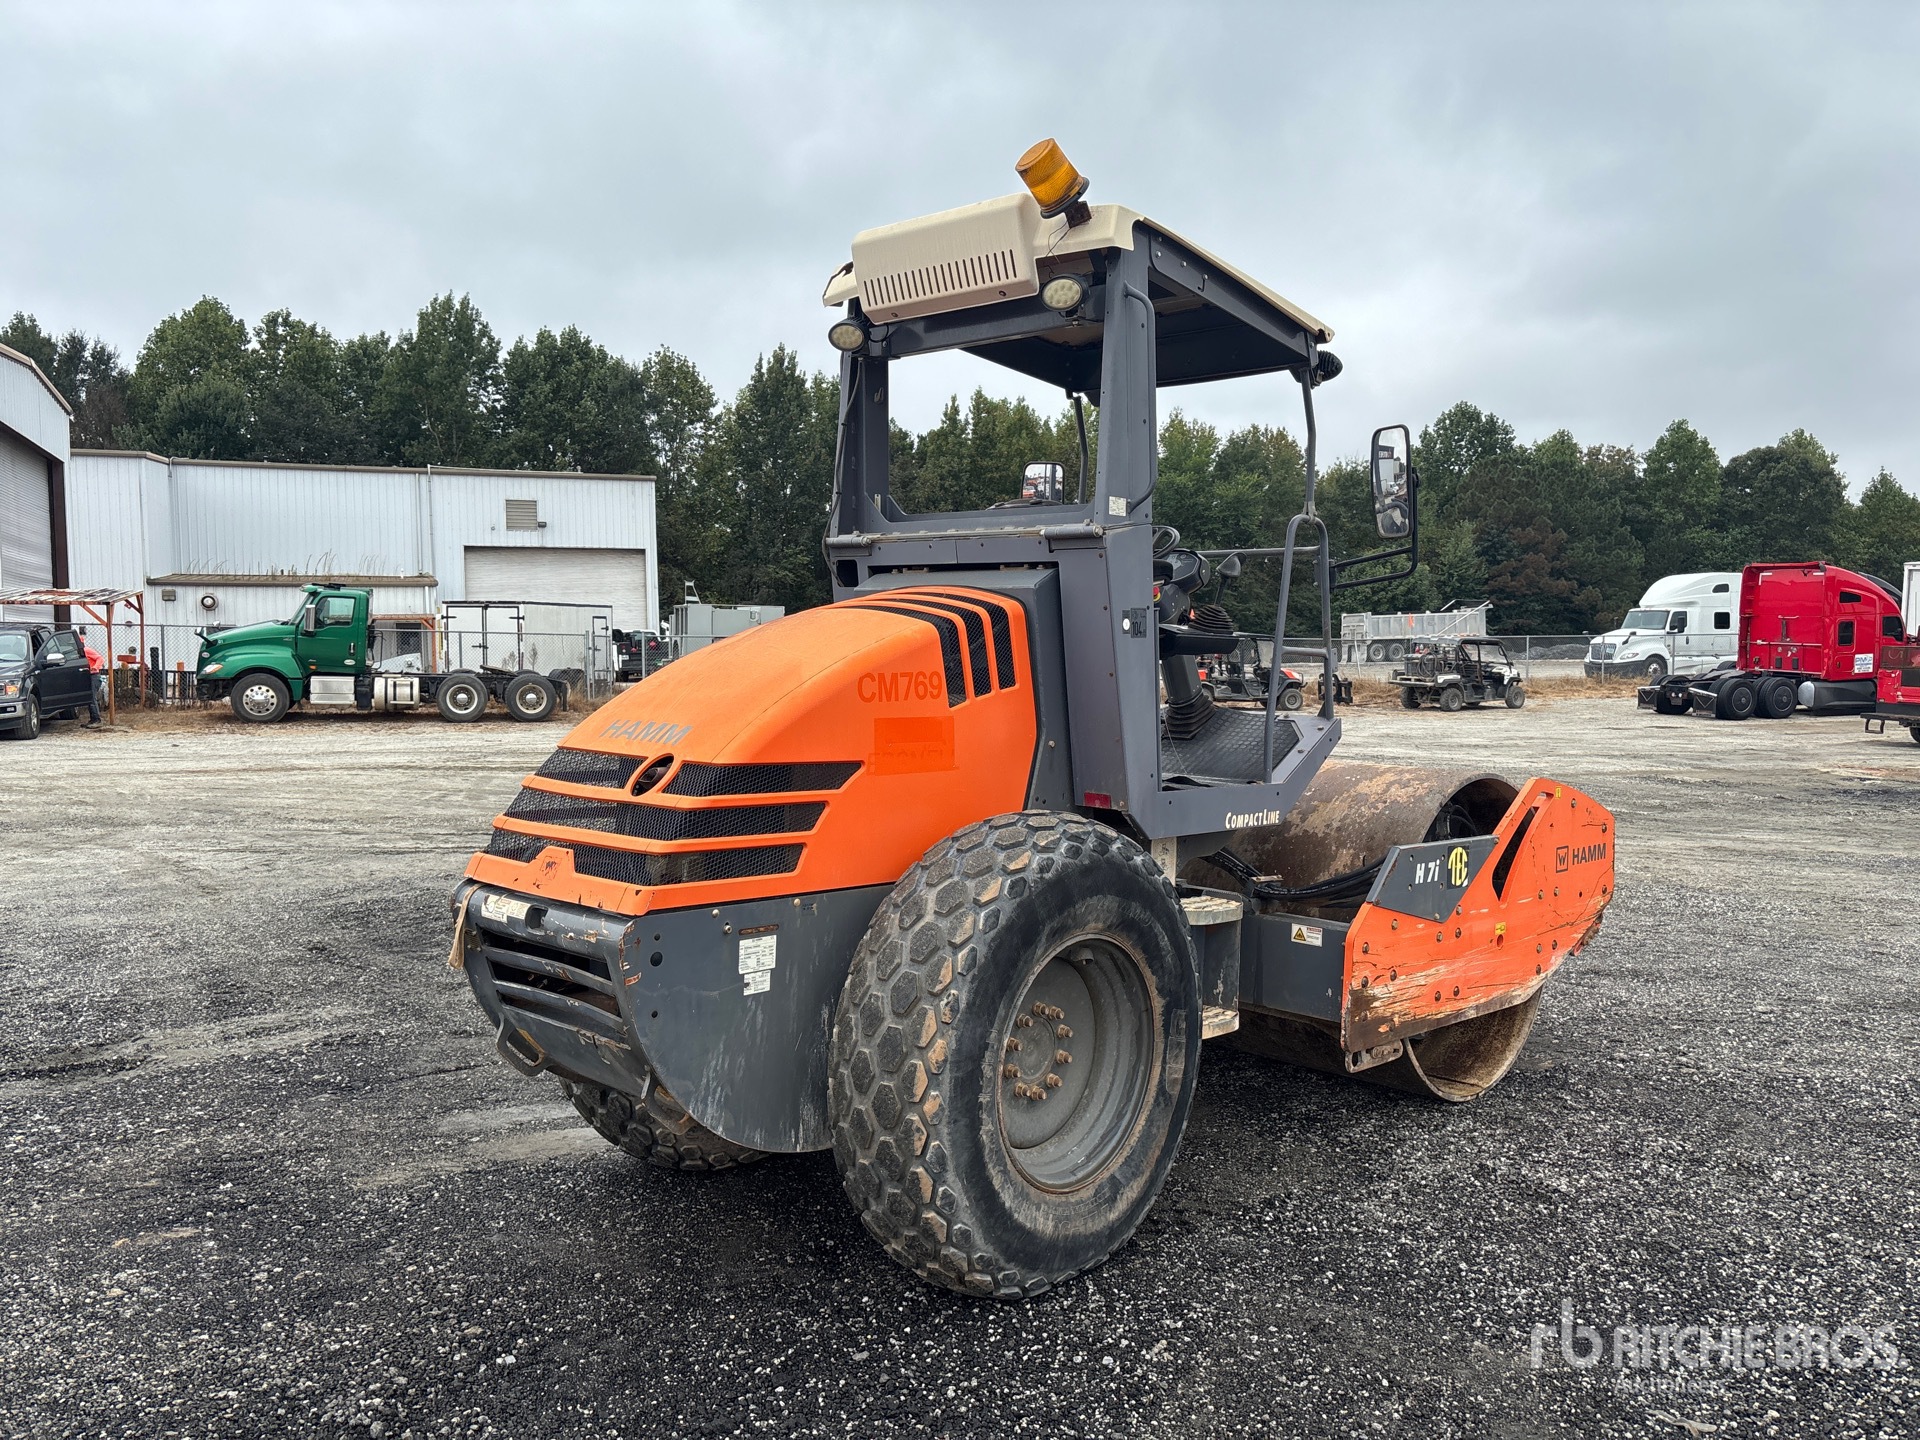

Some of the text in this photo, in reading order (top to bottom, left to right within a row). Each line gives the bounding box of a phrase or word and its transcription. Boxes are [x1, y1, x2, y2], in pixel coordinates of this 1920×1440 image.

[857, 670, 943, 703] CM769
[599, 719, 693, 746] HAMM
[1572, 843, 1606, 865] HAMM
[1415, 859, 1440, 885] H 7i
